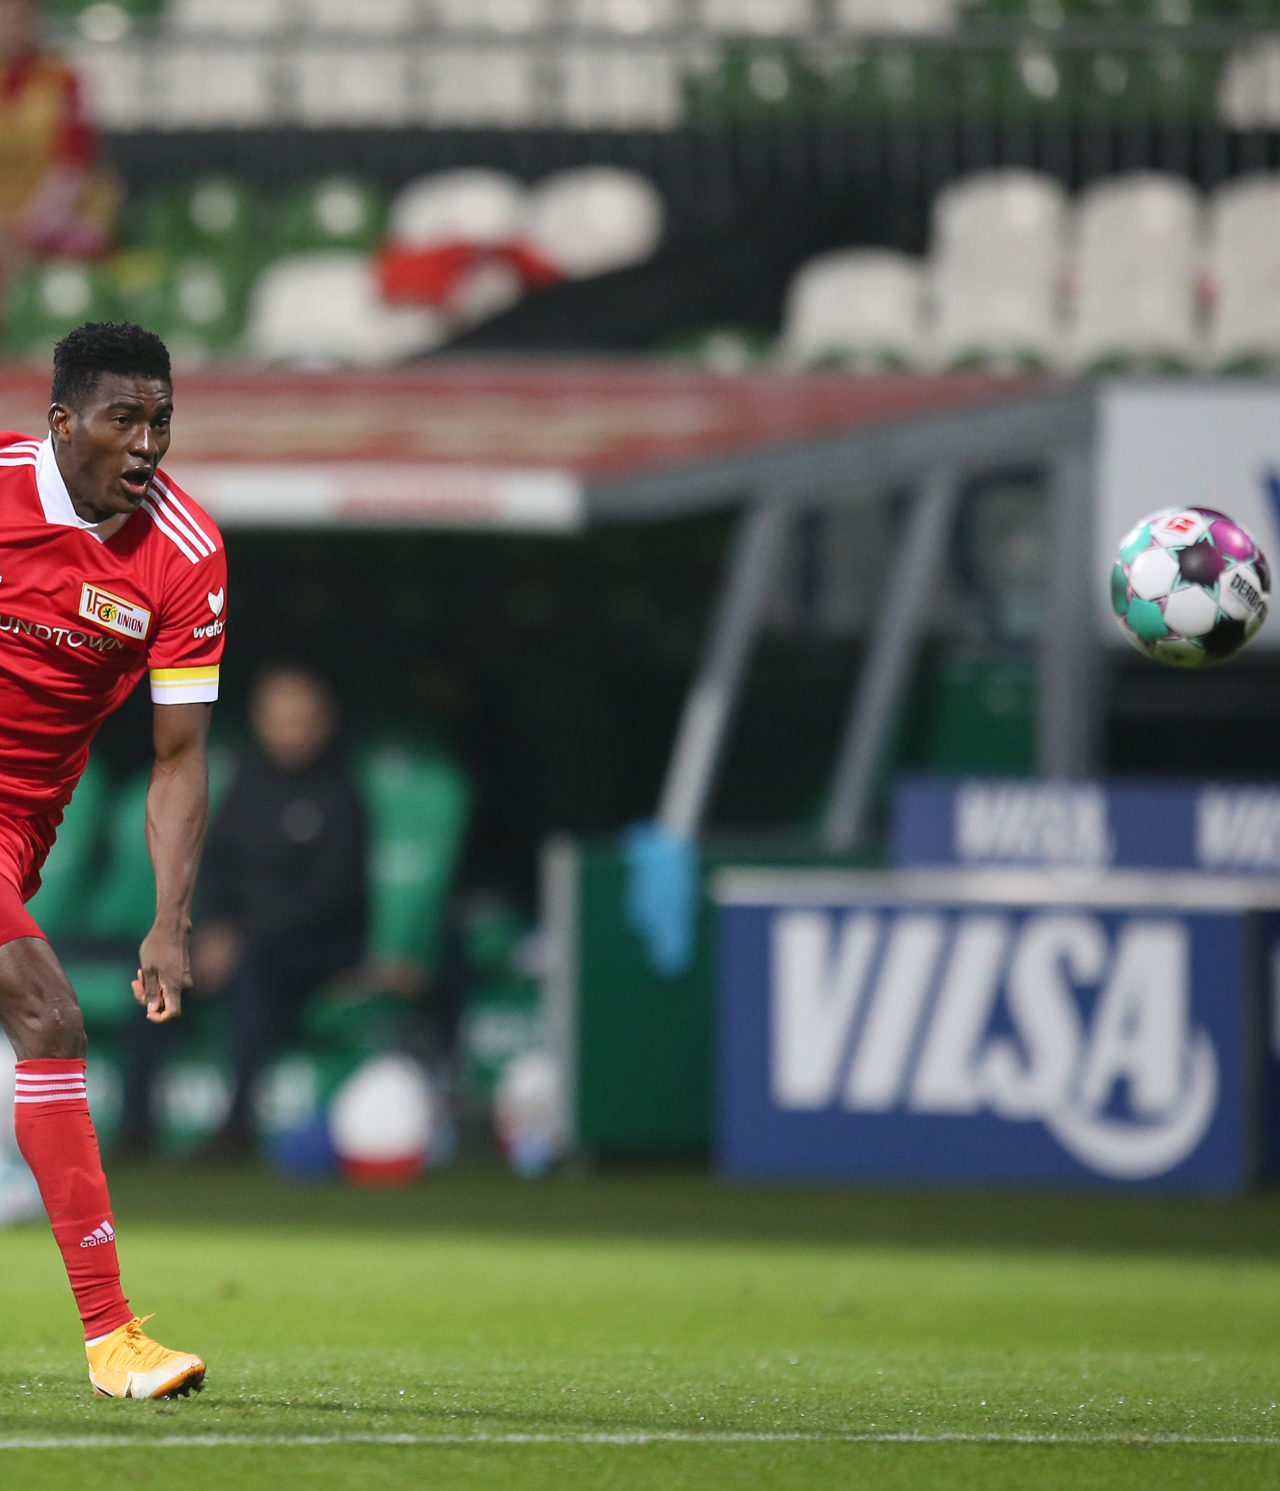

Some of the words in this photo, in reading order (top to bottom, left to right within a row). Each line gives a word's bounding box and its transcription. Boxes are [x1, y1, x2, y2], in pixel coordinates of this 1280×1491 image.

[117, 611, 144, 633] UNION
[193, 619, 226, 638] wefo
[772, 912, 1218, 1180] VILSA
[80, 1233, 115, 1248] adida
